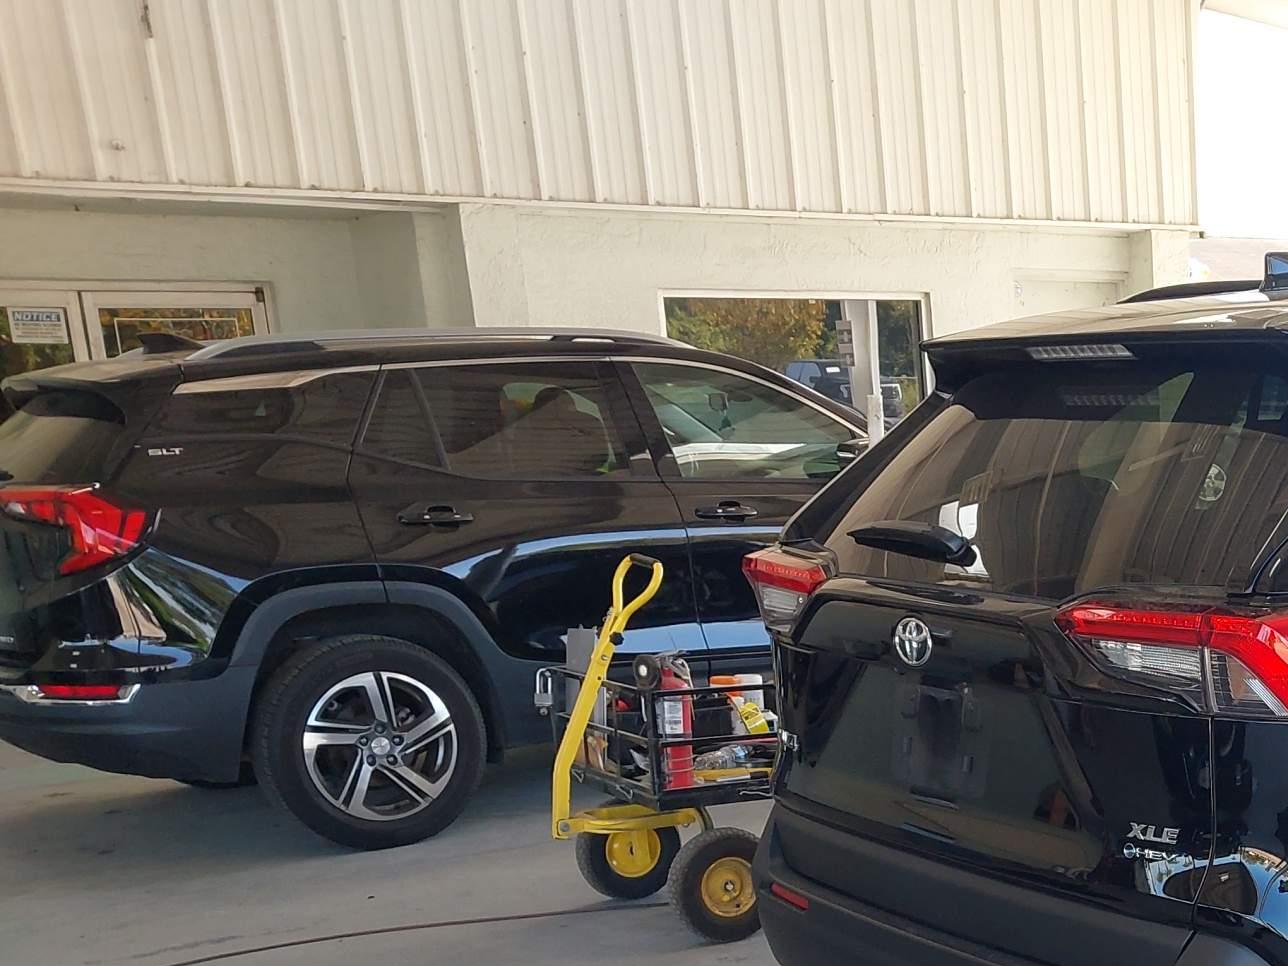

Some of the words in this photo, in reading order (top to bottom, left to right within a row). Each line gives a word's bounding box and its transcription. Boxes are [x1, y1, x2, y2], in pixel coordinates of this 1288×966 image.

[14, 311, 58, 321] NOTICE
[148, 447, 183, 456] SLT
[1126, 822, 1180, 845] XLE
[1136, 847, 1178, 861] HEV
